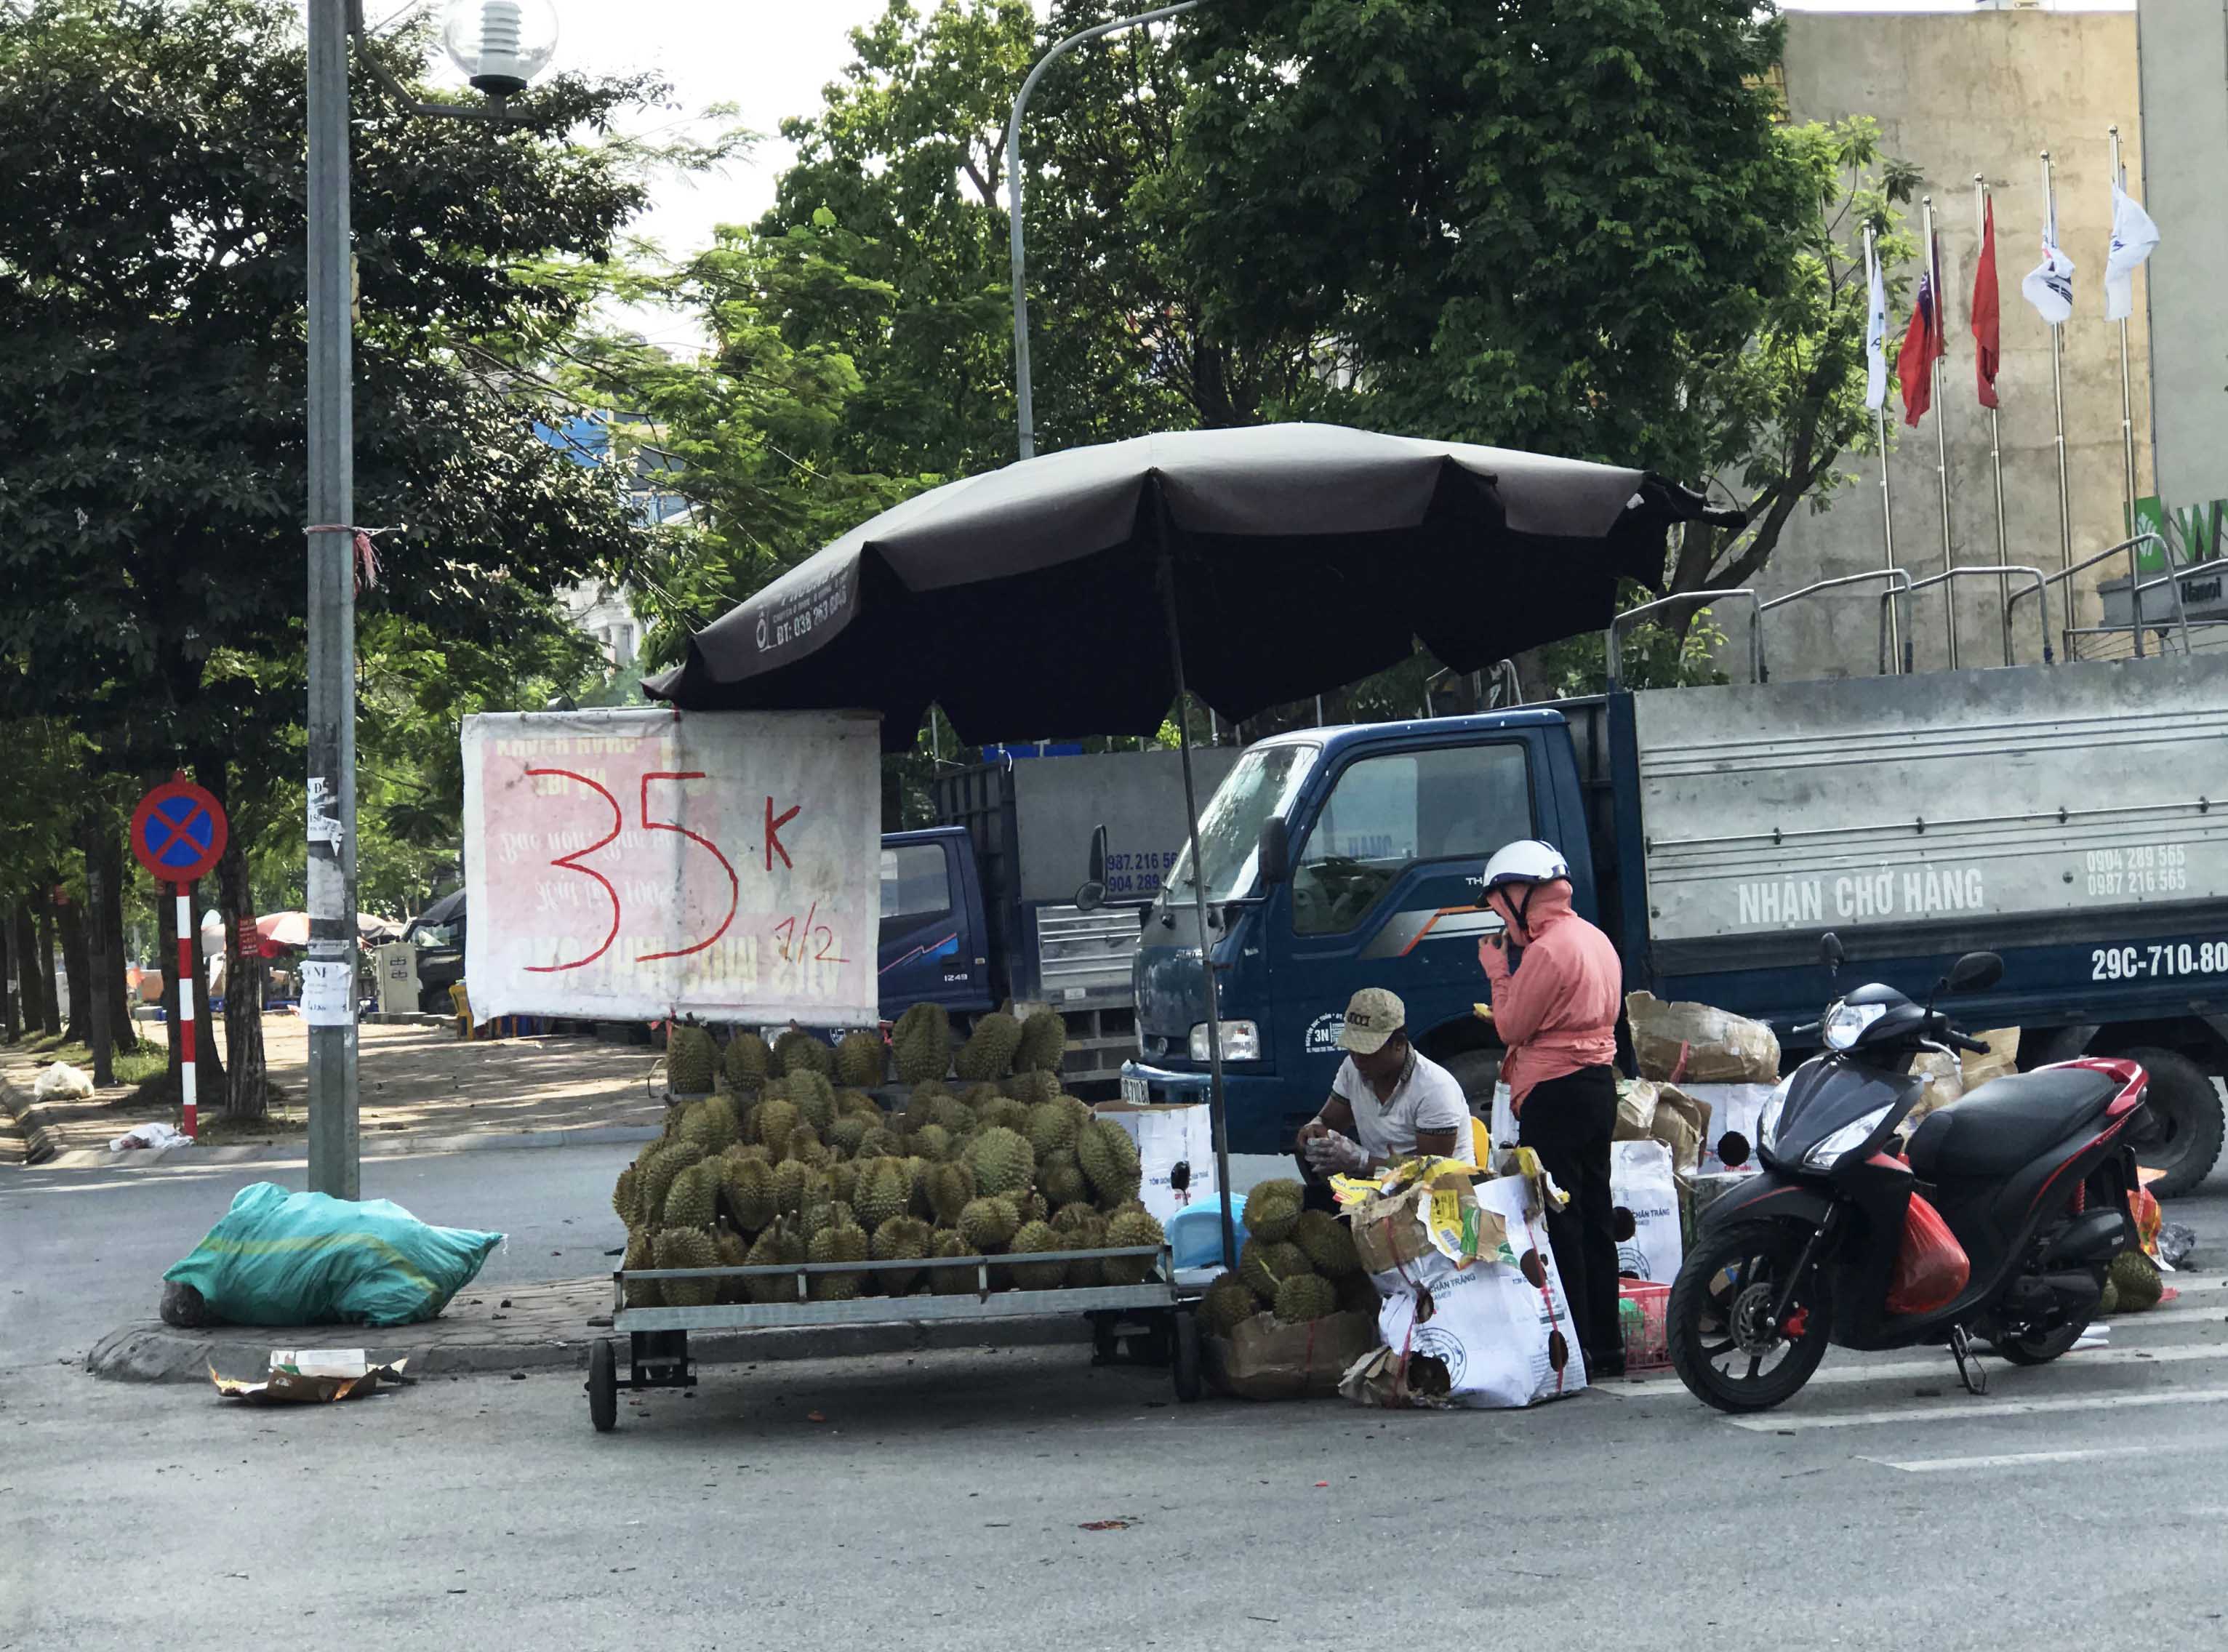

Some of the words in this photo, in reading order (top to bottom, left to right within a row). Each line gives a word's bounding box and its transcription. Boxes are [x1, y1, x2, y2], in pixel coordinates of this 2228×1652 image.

[523, 769, 738, 972] 35
[766, 797, 801, 871] K
[1105, 853, 1159, 870] 987.216
[1163, 851, 1178, 868] 56
[2087, 848, 2123, 873] 0904
[2127, 846, 2154, 870] 289
[2158, 844, 2186, 867] 565
[1109, 875, 1132, 892] 904
[1137, 874, 1160, 891] 289
[1465, 876, 1483, 885] TH
[1739, 875, 1823, 929] NHẬN
[1836, 861, 1894, 918] CHỞ
[1903, 862, 1984, 914] HÀNG
[2088, 872, 2123, 897] 0987
[2128, 870, 2155, 893] 216
[2159, 868, 2187, 891] 565
[775, 902, 851, 965] 1/2
[2091, 941, 2228, 981] 29C-710.80
[1314, 1029, 1329, 1042] 3N
